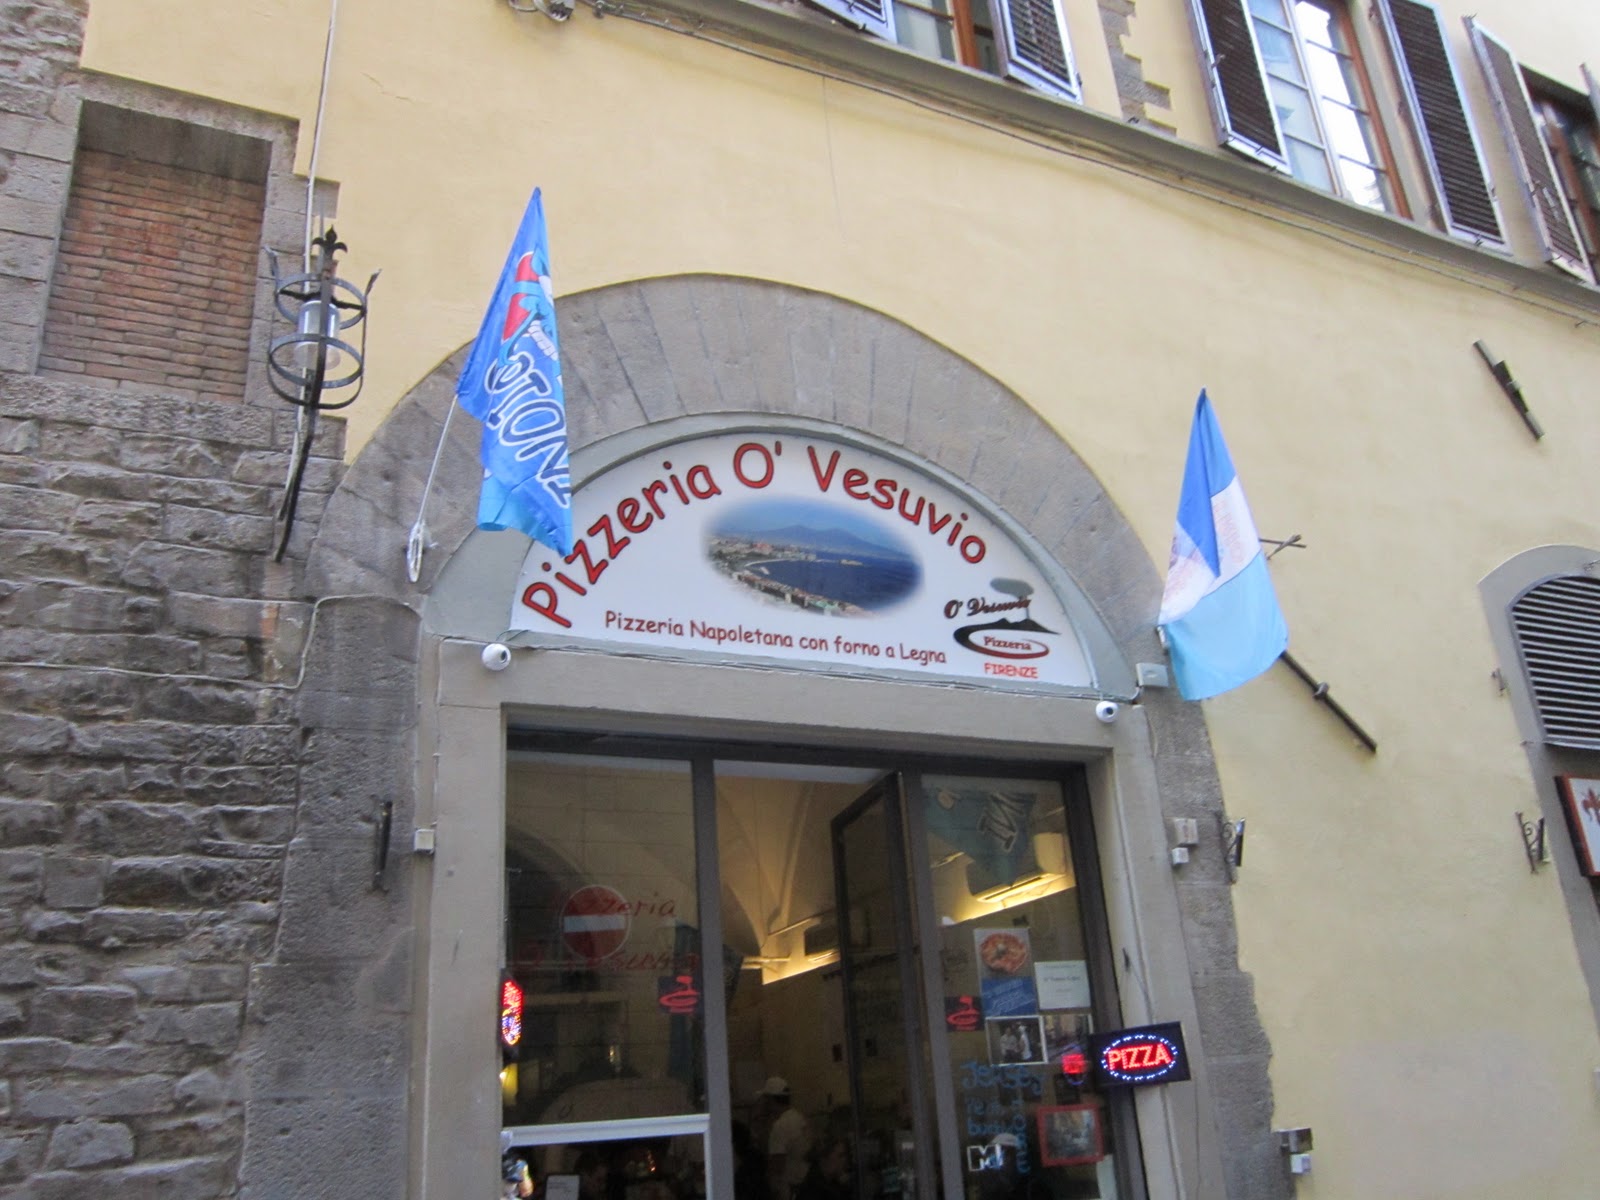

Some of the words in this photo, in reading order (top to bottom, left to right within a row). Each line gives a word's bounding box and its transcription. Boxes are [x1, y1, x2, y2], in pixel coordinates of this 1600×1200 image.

[521, 460, 722, 630] Pizzeria
[732, 440, 783, 490] O'
[807, 445, 987, 564] Vesuvio
[605, 610, 684, 636] Pizzeria
[689, 620, 793, 648] Napoletana
[799, 635, 828, 651] con
[833, 635, 880, 657] forno
[885, 646, 896, 658] a
[899, 643, 947, 667] Legna
[983, 636, 1032, 651] Pizzeria
[984, 663, 1039, 679] FIRENZE
[1107, 1043, 1171, 1071] PIZZA
